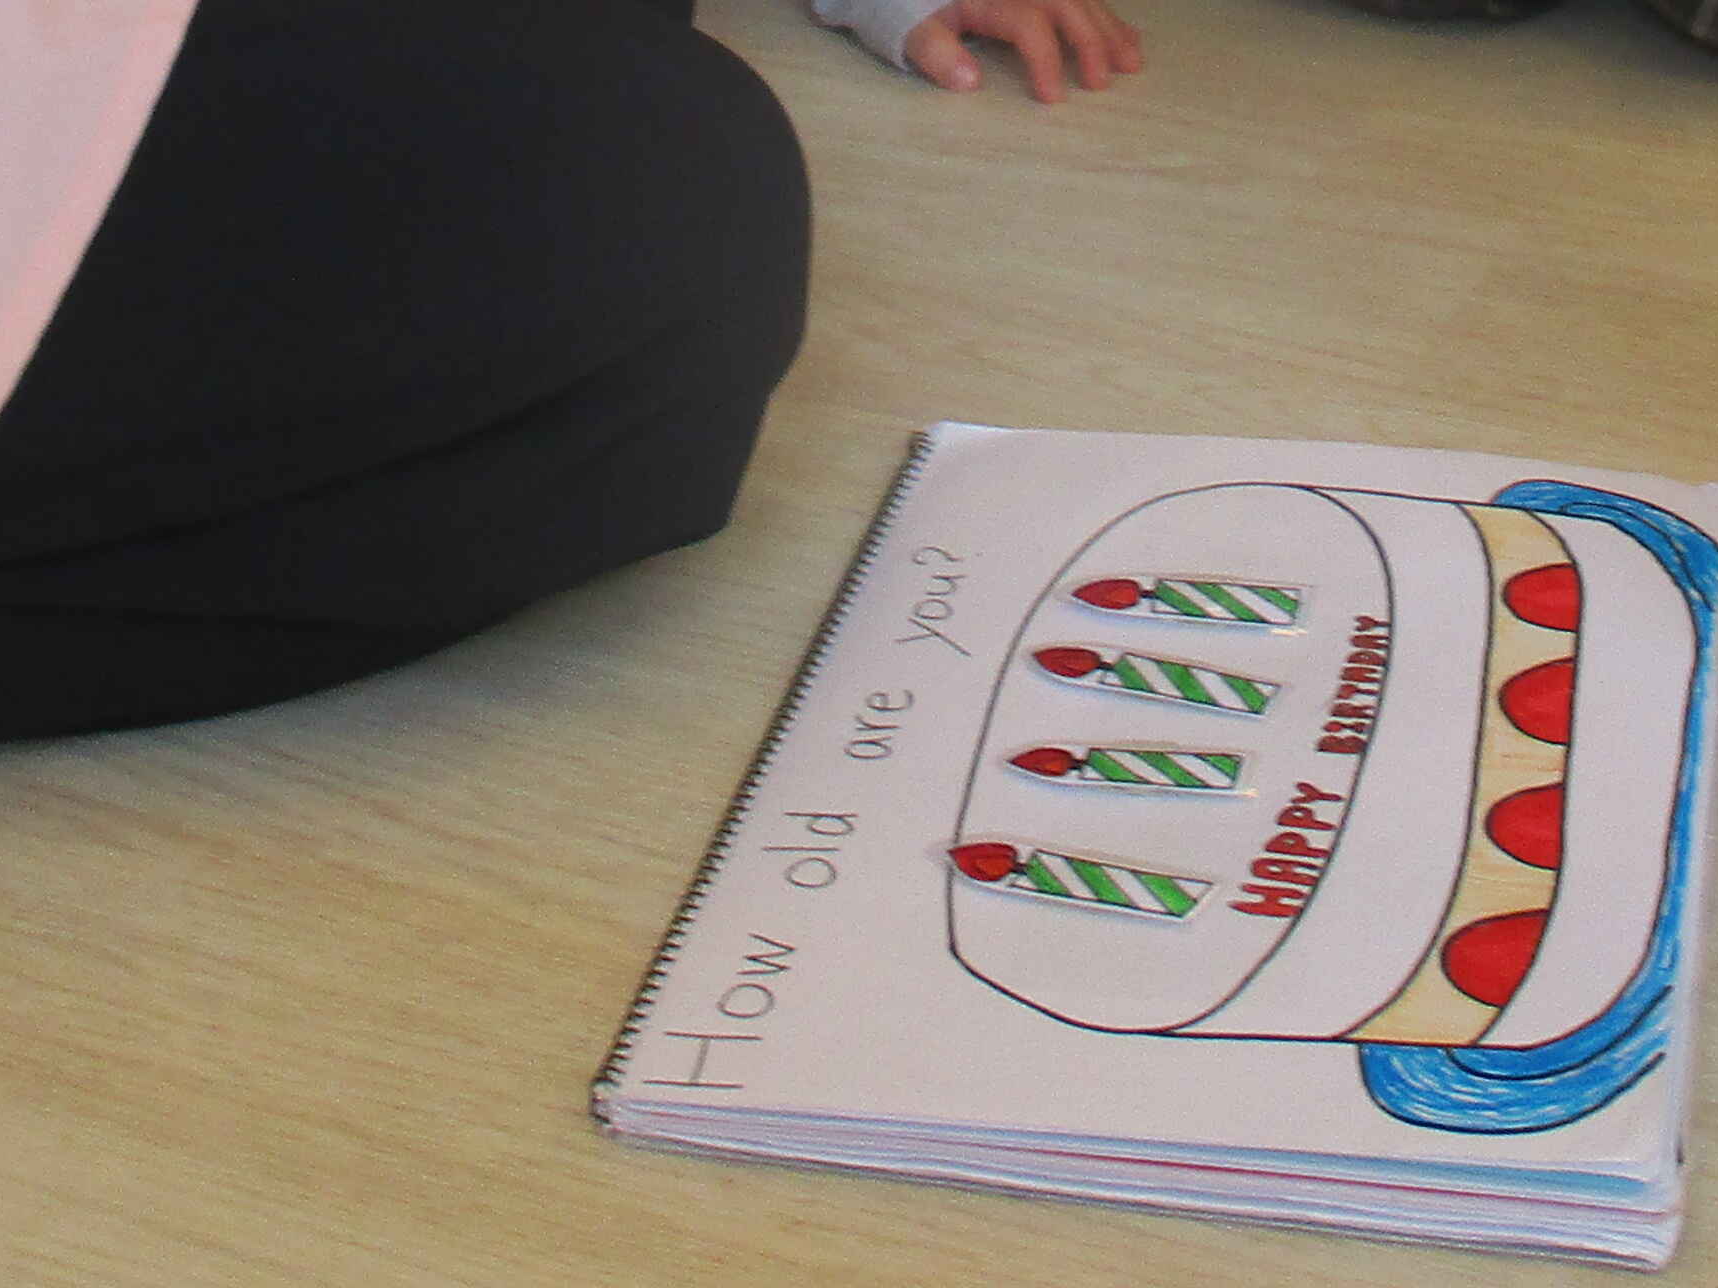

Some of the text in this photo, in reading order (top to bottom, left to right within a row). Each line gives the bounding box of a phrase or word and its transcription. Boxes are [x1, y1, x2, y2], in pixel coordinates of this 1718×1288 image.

[643, 545, 973, 1090] How old are you?
[1227, 615, 1390, 918] HAPPY BIRTHDAY
